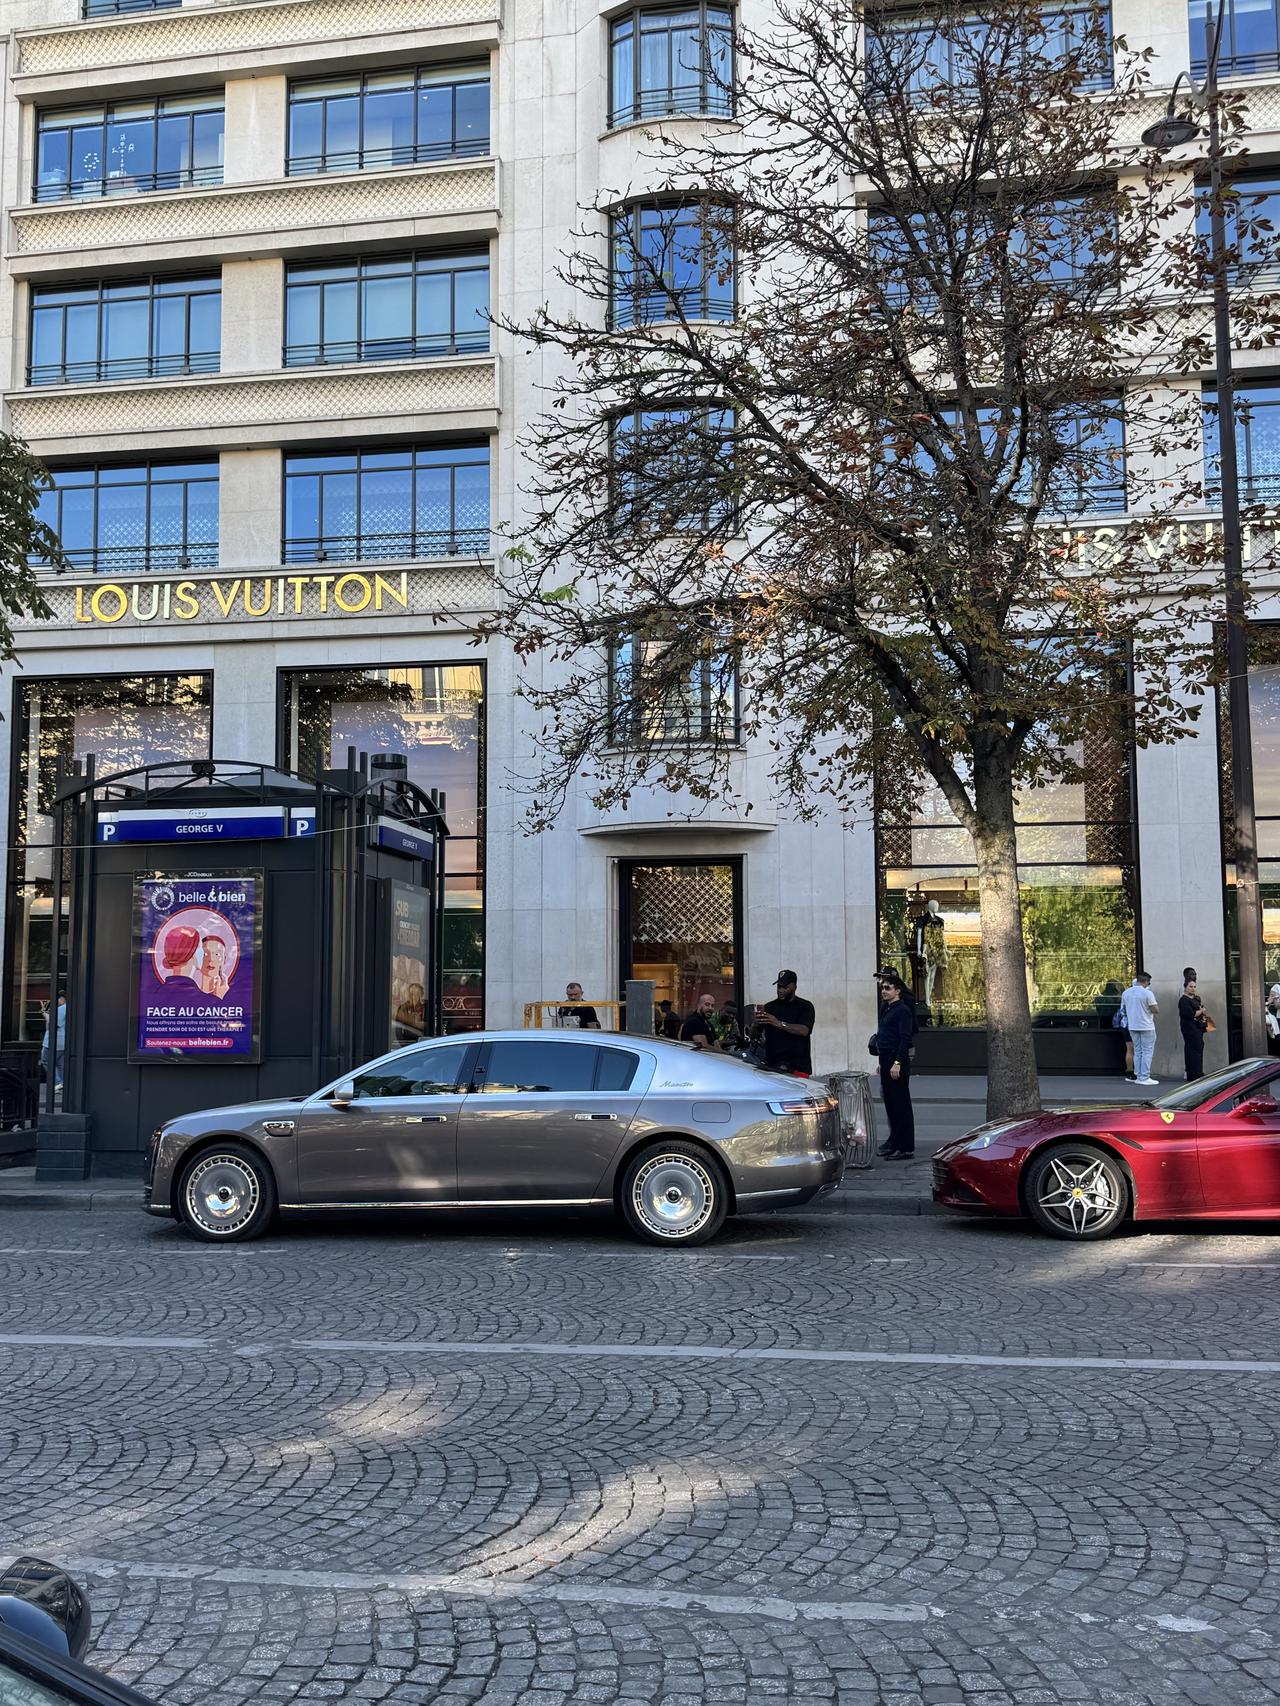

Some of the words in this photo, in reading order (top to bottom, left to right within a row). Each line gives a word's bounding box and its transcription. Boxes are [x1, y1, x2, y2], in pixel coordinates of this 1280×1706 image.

[75, 581, 200, 623] LOUIS
[210, 572, 408, 618] VUITTON
[103, 825, 116, 841] P
[175, 825, 214, 834] GEORGE
[216, 824, 224, 833] V
[296, 820, 310, 837] P
[178, 891, 206, 903] belle
[218, 890, 246, 903] bien
[146, 1006, 176, 1017] FACE
[178, 1006, 194, 1017] AU
[196, 1006, 243, 1017] CANCER
[188, 1038, 229, 1046] bellebien.fr
